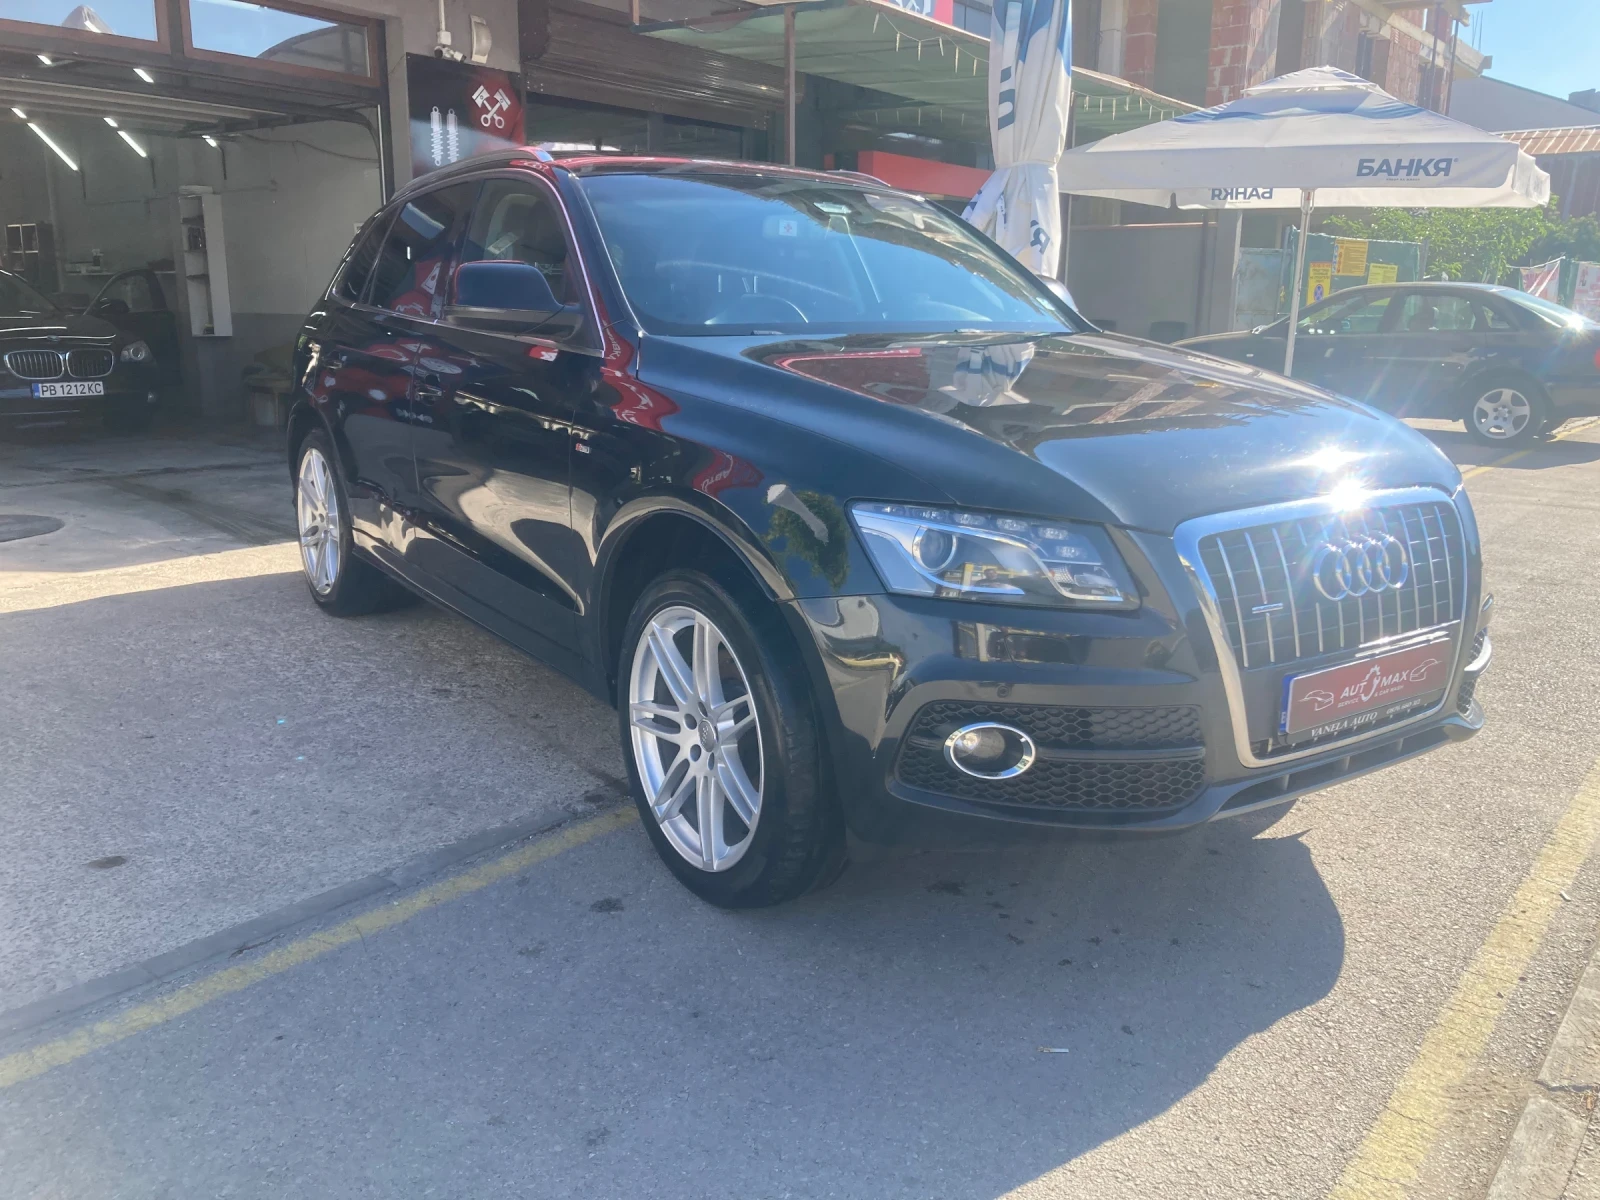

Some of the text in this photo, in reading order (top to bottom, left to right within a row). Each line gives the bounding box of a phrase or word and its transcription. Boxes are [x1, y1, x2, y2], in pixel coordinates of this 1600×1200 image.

[1356, 158, 1453, 177] БАНКЯ
[41, 384, 57, 396] PB
[1311, 711, 1378, 738] VANELA AUTO
